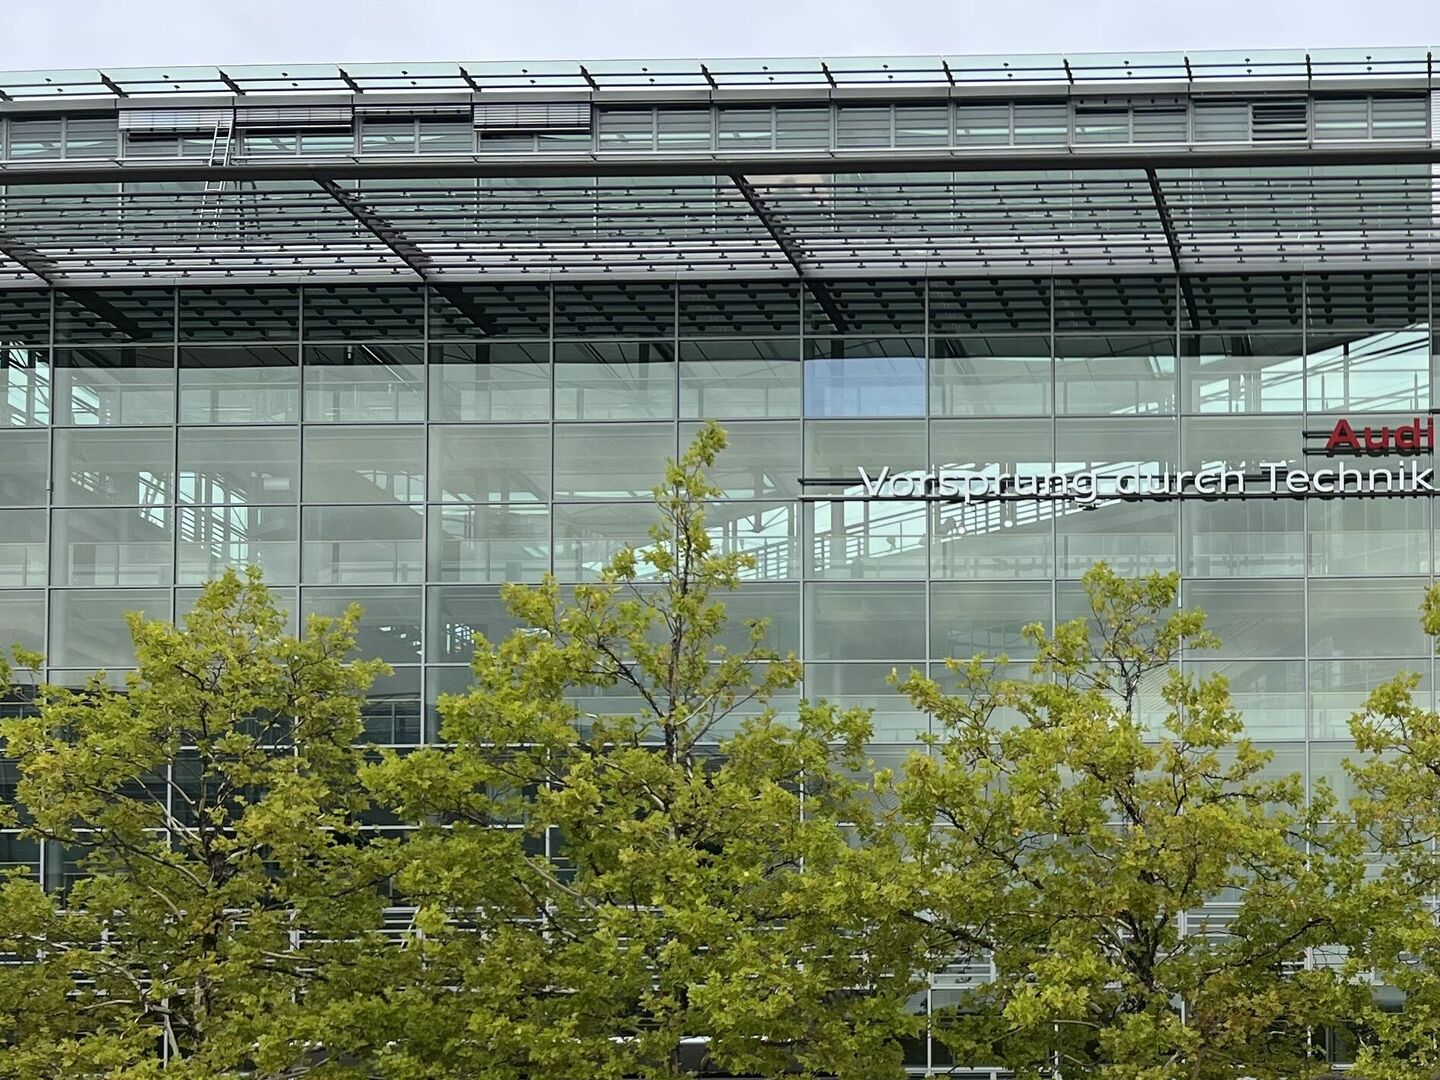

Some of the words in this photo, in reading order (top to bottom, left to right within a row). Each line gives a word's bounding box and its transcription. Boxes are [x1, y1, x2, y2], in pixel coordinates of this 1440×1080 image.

[1326, 418, 1434, 449] Audi
[857, 466, 1098, 504] Vorsprung
[1115, 461, 1244, 494] durch
[1259, 460, 1435, 494] Technik
